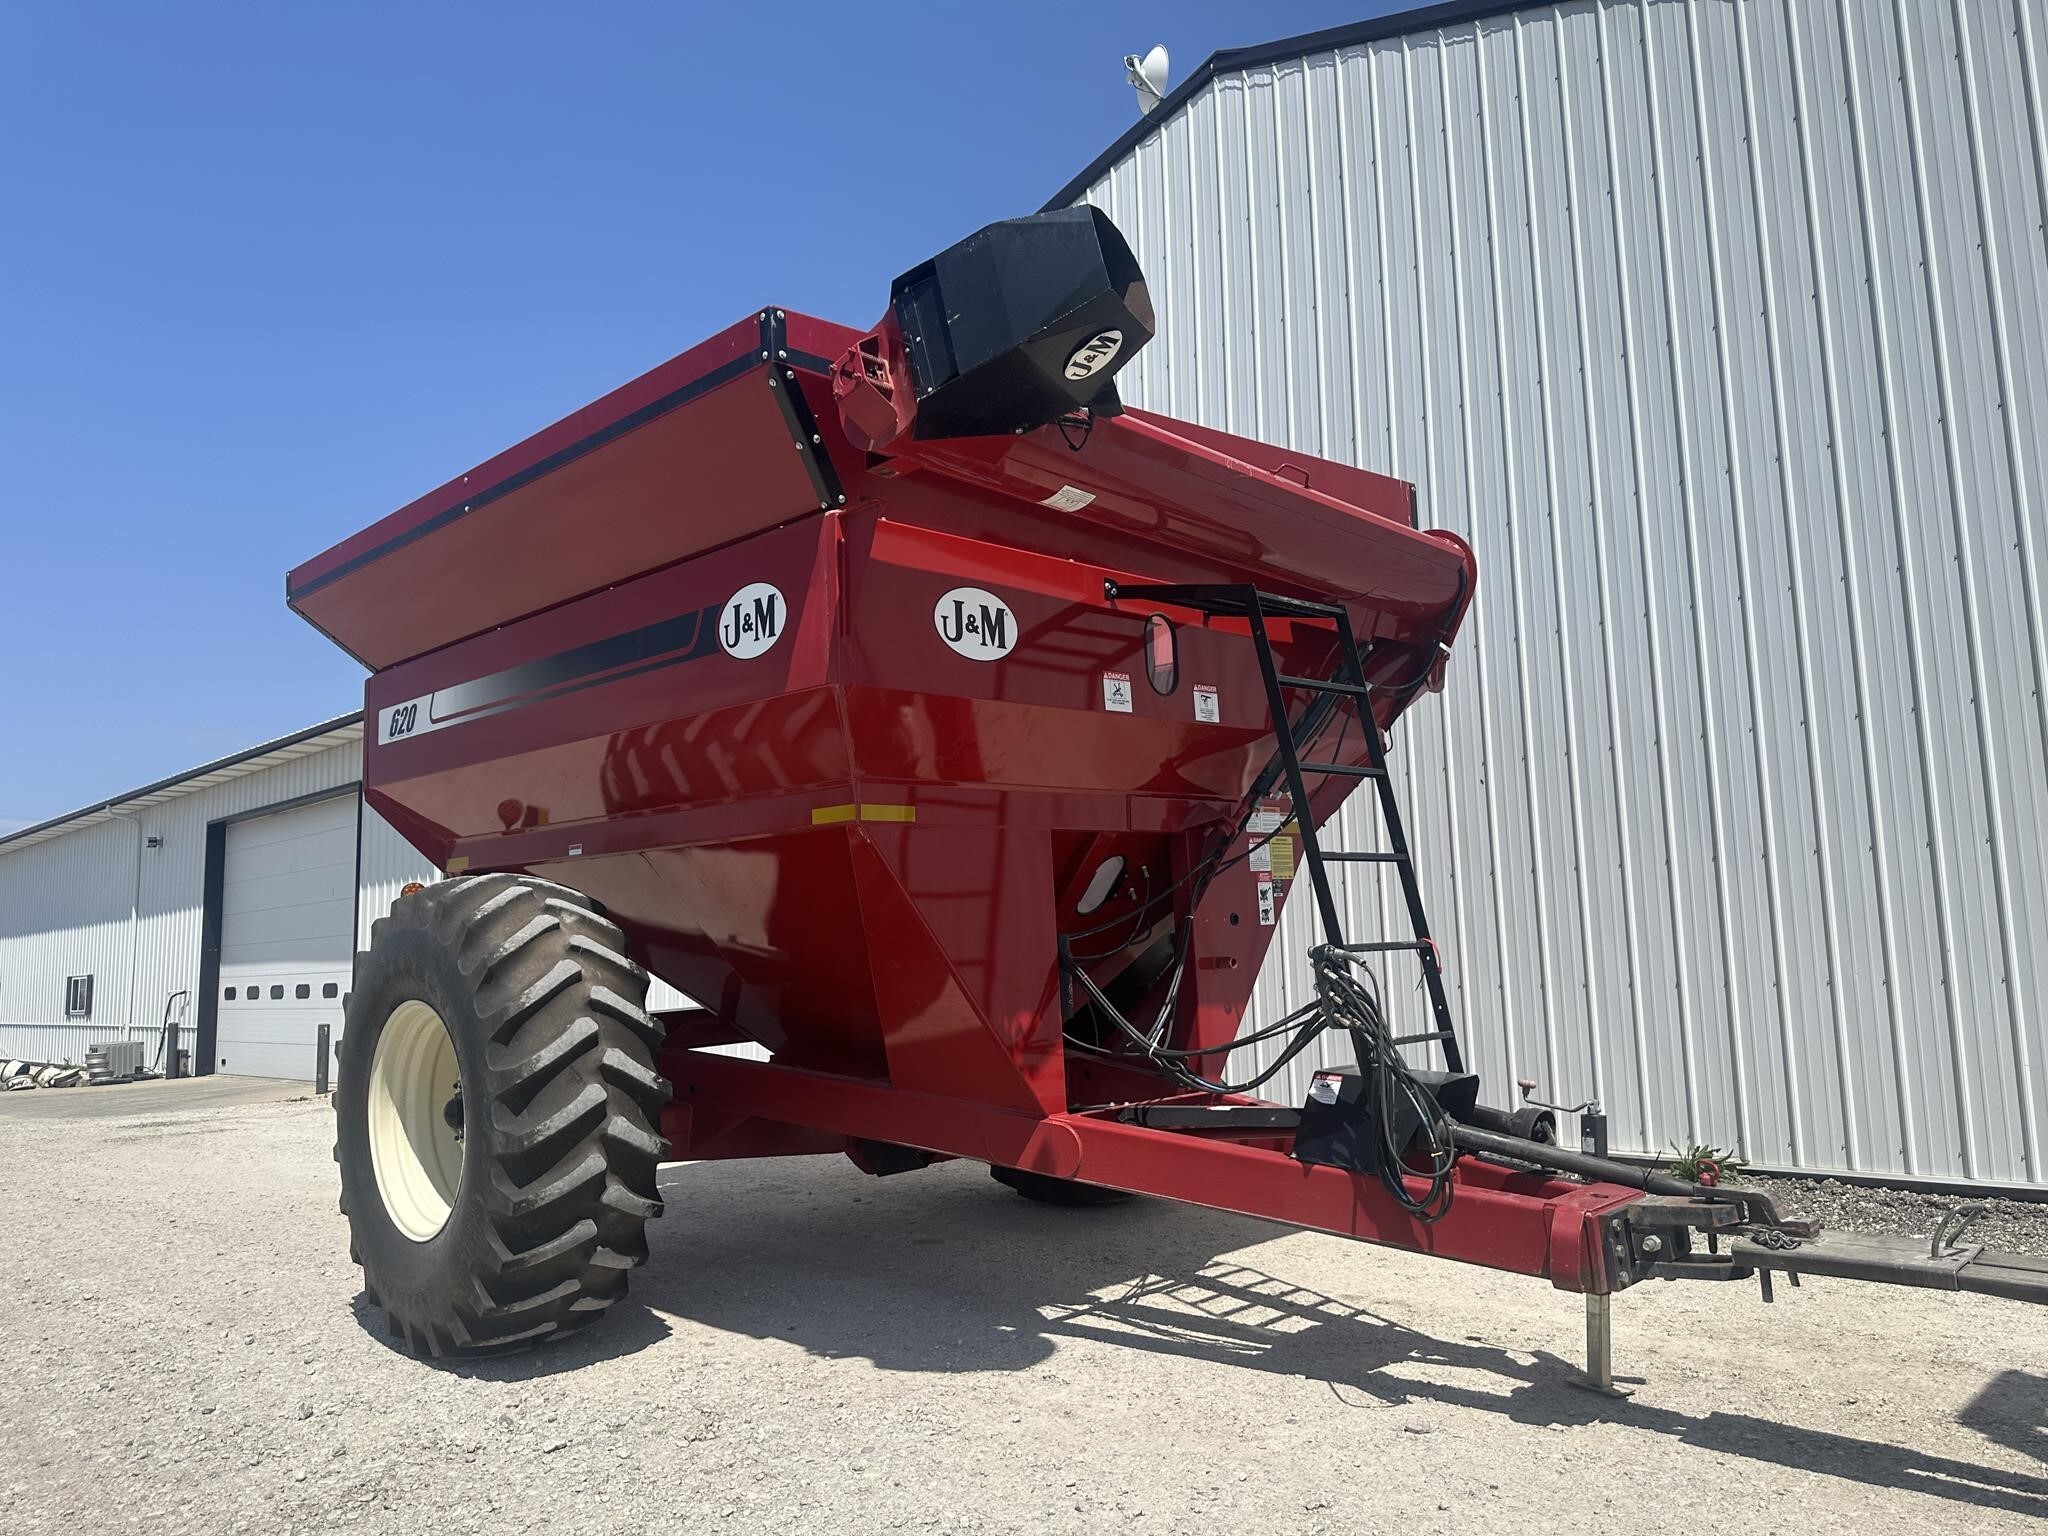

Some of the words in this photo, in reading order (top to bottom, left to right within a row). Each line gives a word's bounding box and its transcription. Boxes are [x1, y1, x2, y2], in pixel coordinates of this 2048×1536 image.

[1070, 335, 1120, 377] J&M
[723, 593, 777, 649] J&M
[941, 599, 1008, 650] J&M
[1108, 673, 1130, 681] DANGER
[389, 703, 418, 738] 620
